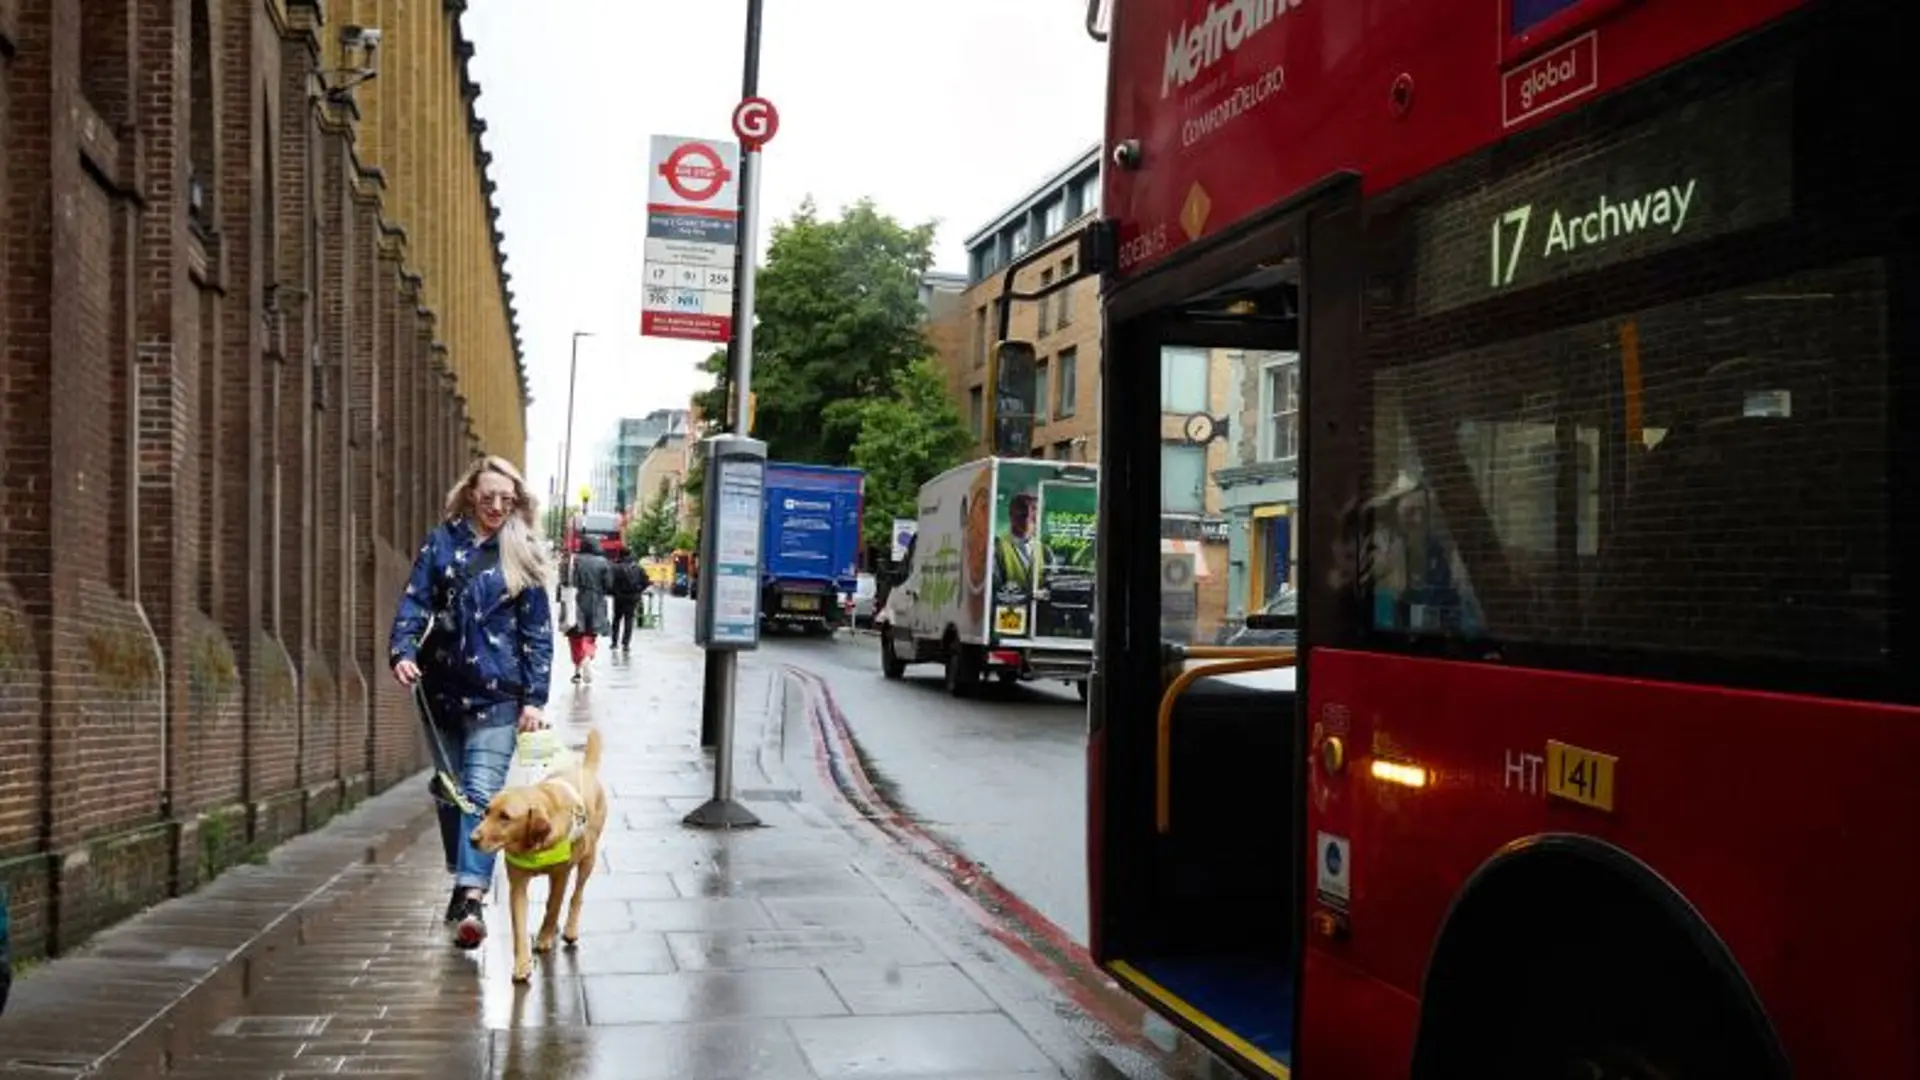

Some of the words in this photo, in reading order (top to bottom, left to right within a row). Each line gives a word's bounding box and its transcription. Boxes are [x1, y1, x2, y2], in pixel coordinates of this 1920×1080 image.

[1161, 0, 1301, 99] Metrolin
[1521, 48, 1576, 109] global
[737, 102, 768, 136] G
[1490, 205, 1532, 287] 17
[1544, 179, 1696, 256] Archway
[1504, 748, 1543, 796] HT
[1558, 752, 1599, 800] 141
